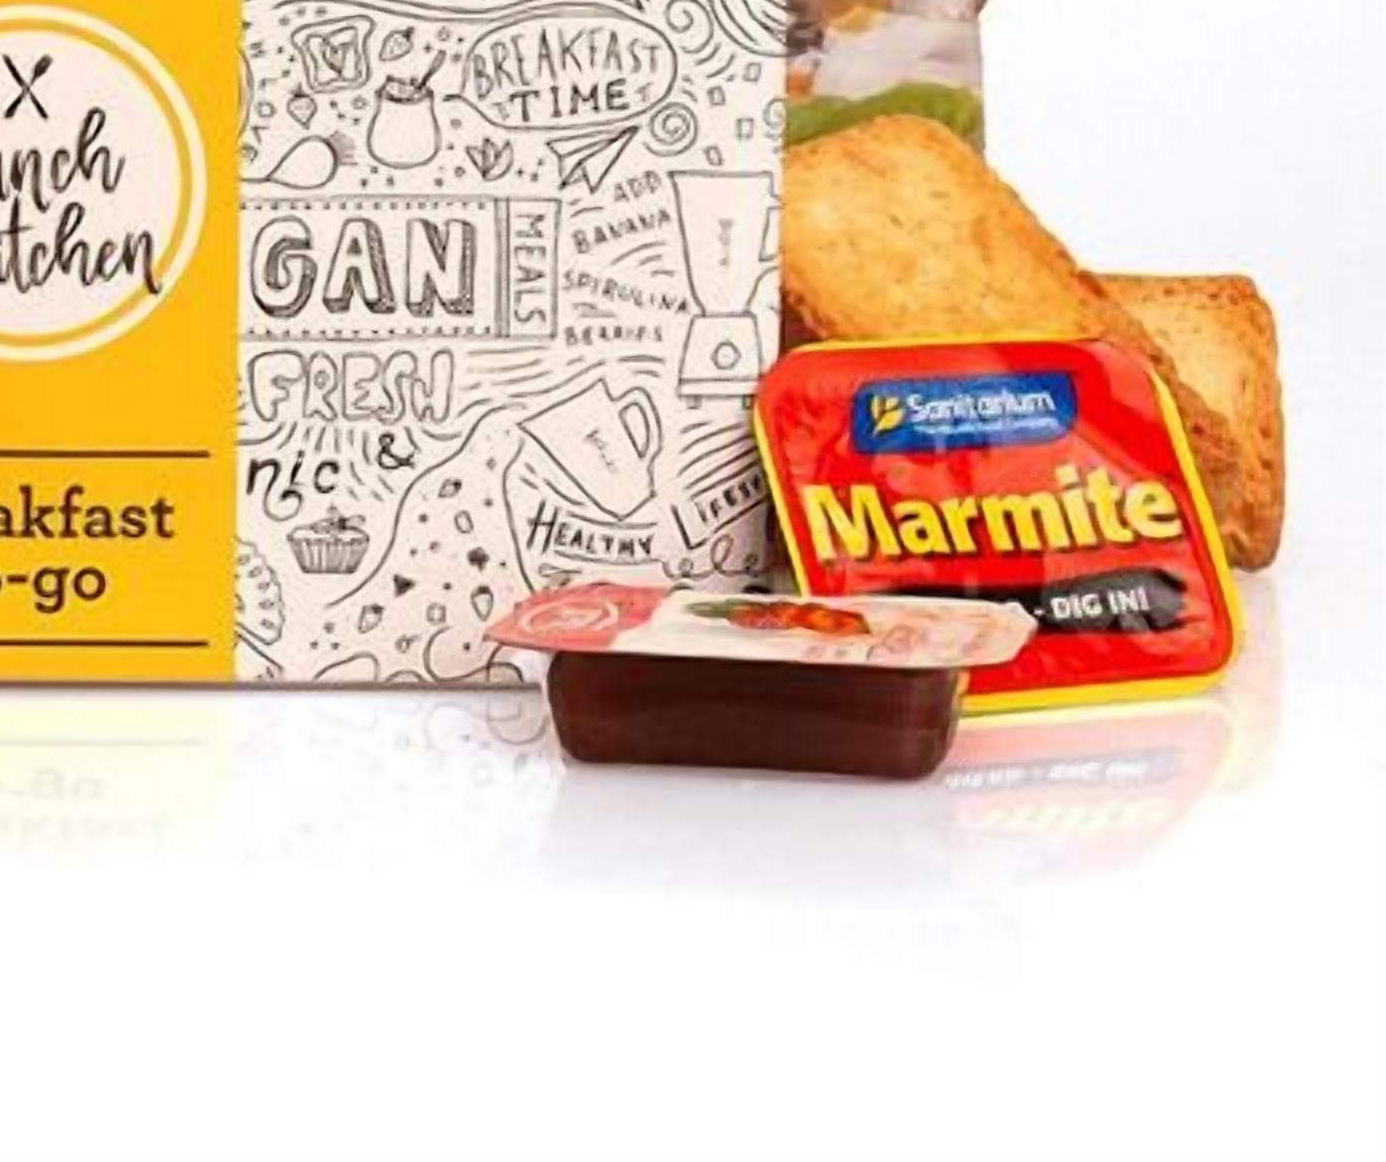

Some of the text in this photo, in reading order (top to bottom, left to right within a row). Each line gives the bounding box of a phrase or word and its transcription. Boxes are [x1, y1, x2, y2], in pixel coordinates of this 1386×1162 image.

[473, 26, 661, 101] BREAKFAST
[510, 78, 631, 122] TIME
[614, 170, 663, 202] ADD
[571, 209, 672, 254] BANANA
[249, 215, 477, 318] GAN
[513, 213, 547, 324] MEALS
[249, 349, 455, 422] FRESH
[526, 499, 655, 557] HEALTHY
[803, 464, 1184, 566] Marmite
[1050, 593, 1104, 620] DIG
